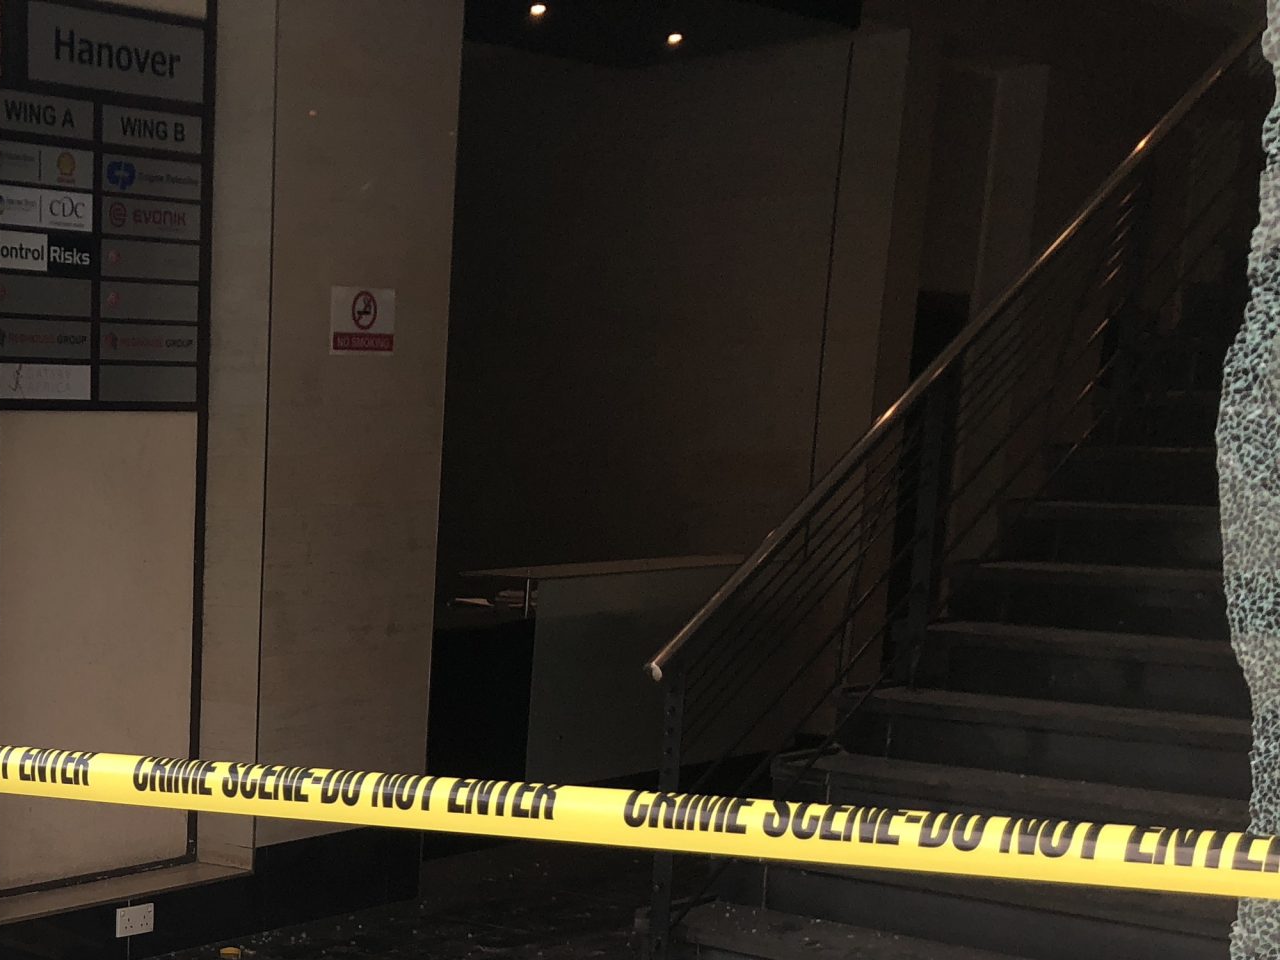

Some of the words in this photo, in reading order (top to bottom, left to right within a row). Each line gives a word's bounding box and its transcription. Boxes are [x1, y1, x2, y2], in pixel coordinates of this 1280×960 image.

[54, 26, 181, 78] Hanover
[4, 100, 56, 126] WING
[62, 105, 74, 128] A
[121, 116, 168, 141] WING
[174, 122, 186, 142] B
[49, 197, 85, 220] CDC
[50, 246, 90, 266] Risks
[56, 335, 87, 345] GROUP
[165, 338, 193, 348] GROUP
[337, 336, 350, 347] NO
[19, 749, 96, 786] ENTER
[132, 756, 217, 796] CRIME
[371, 772, 439, 812] NOT
[446, 778, 559, 820] ENTER
[623, 789, 755, 834] CRIME
[999, 816, 1094, 859] NOT
